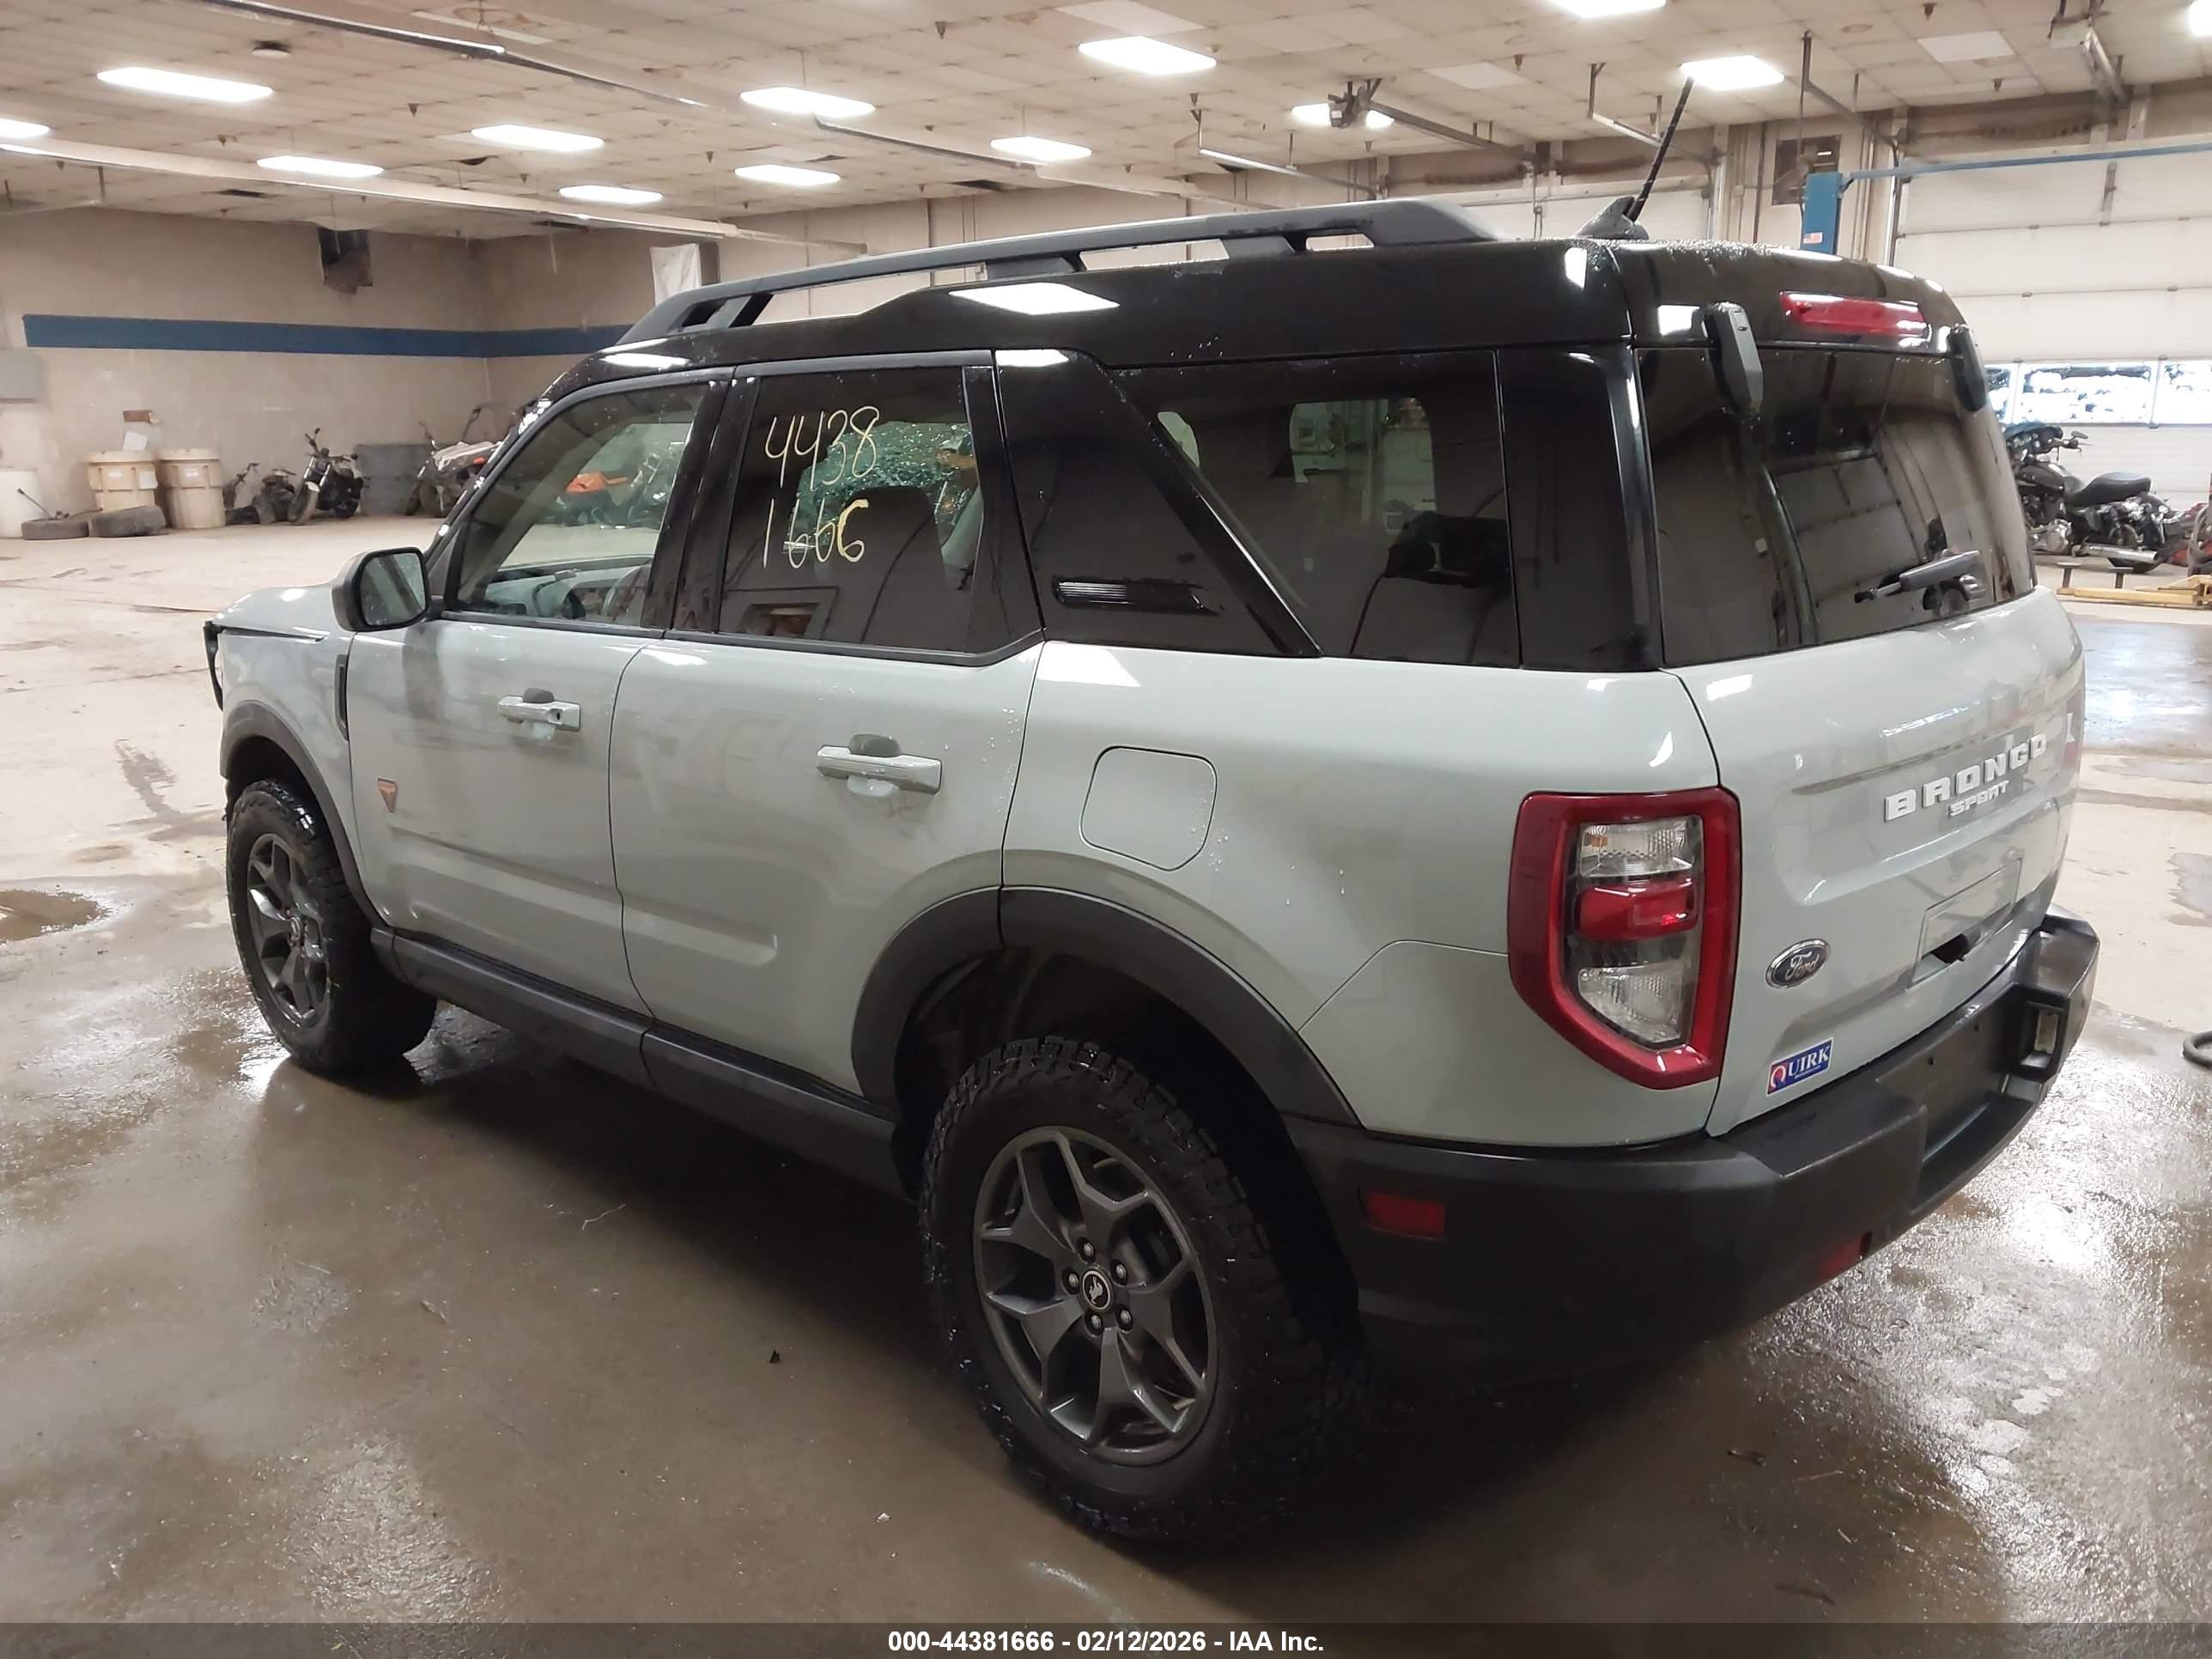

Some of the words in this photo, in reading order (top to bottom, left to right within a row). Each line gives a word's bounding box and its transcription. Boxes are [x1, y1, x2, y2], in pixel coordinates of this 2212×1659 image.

[765, 406, 879, 491] 4438
[763, 498, 870, 568] 1666
[1884, 732, 2047, 822] BRONCO
[1948, 780, 2010, 817] SPORT
[1785, 951, 1820, 979] Ford
[1770, 1045, 1831, 1089] QUIRK
